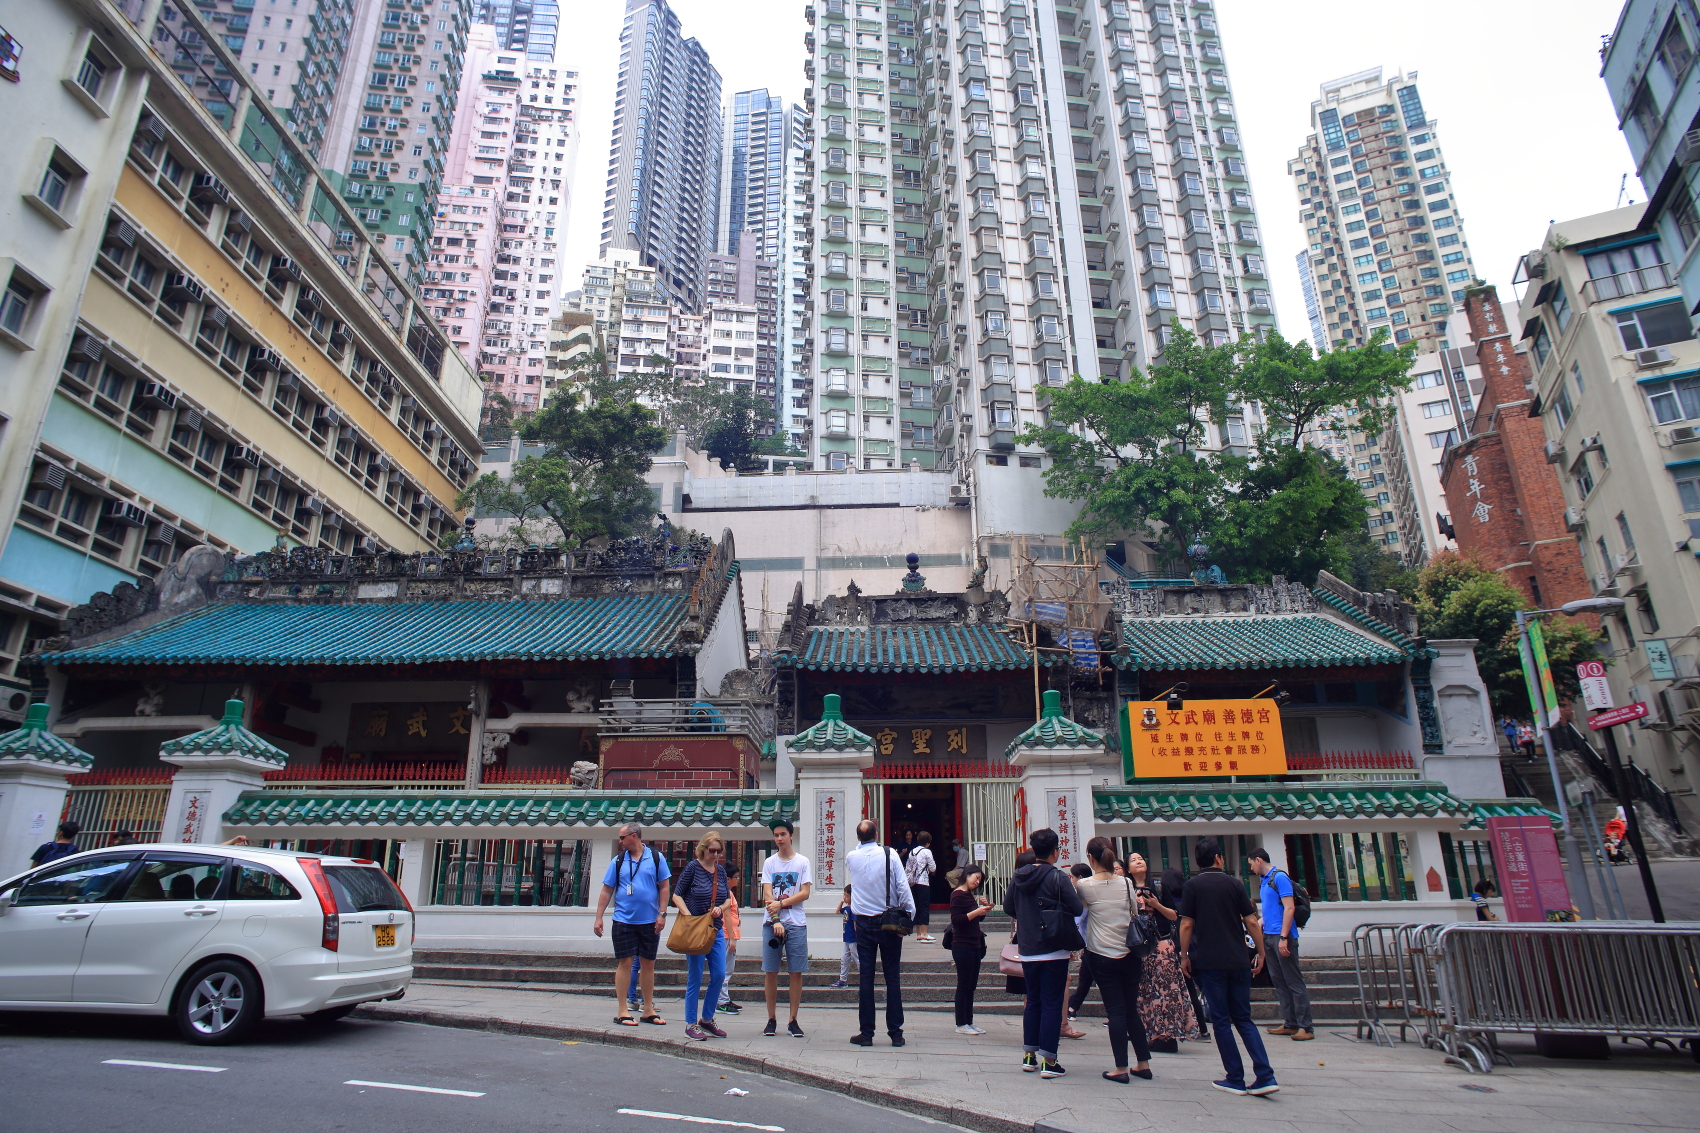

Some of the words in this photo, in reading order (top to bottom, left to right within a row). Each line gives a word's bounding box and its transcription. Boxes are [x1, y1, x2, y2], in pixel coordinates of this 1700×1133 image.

[1493, 342, 1511, 375] 青年會
[1461, 454, 1494, 523] 青年會
[1595, 679, 1608, 705] Central
[1166, 708, 1271, 726] 文武廟善德宮
[377, 936, 395, 946] 2528
